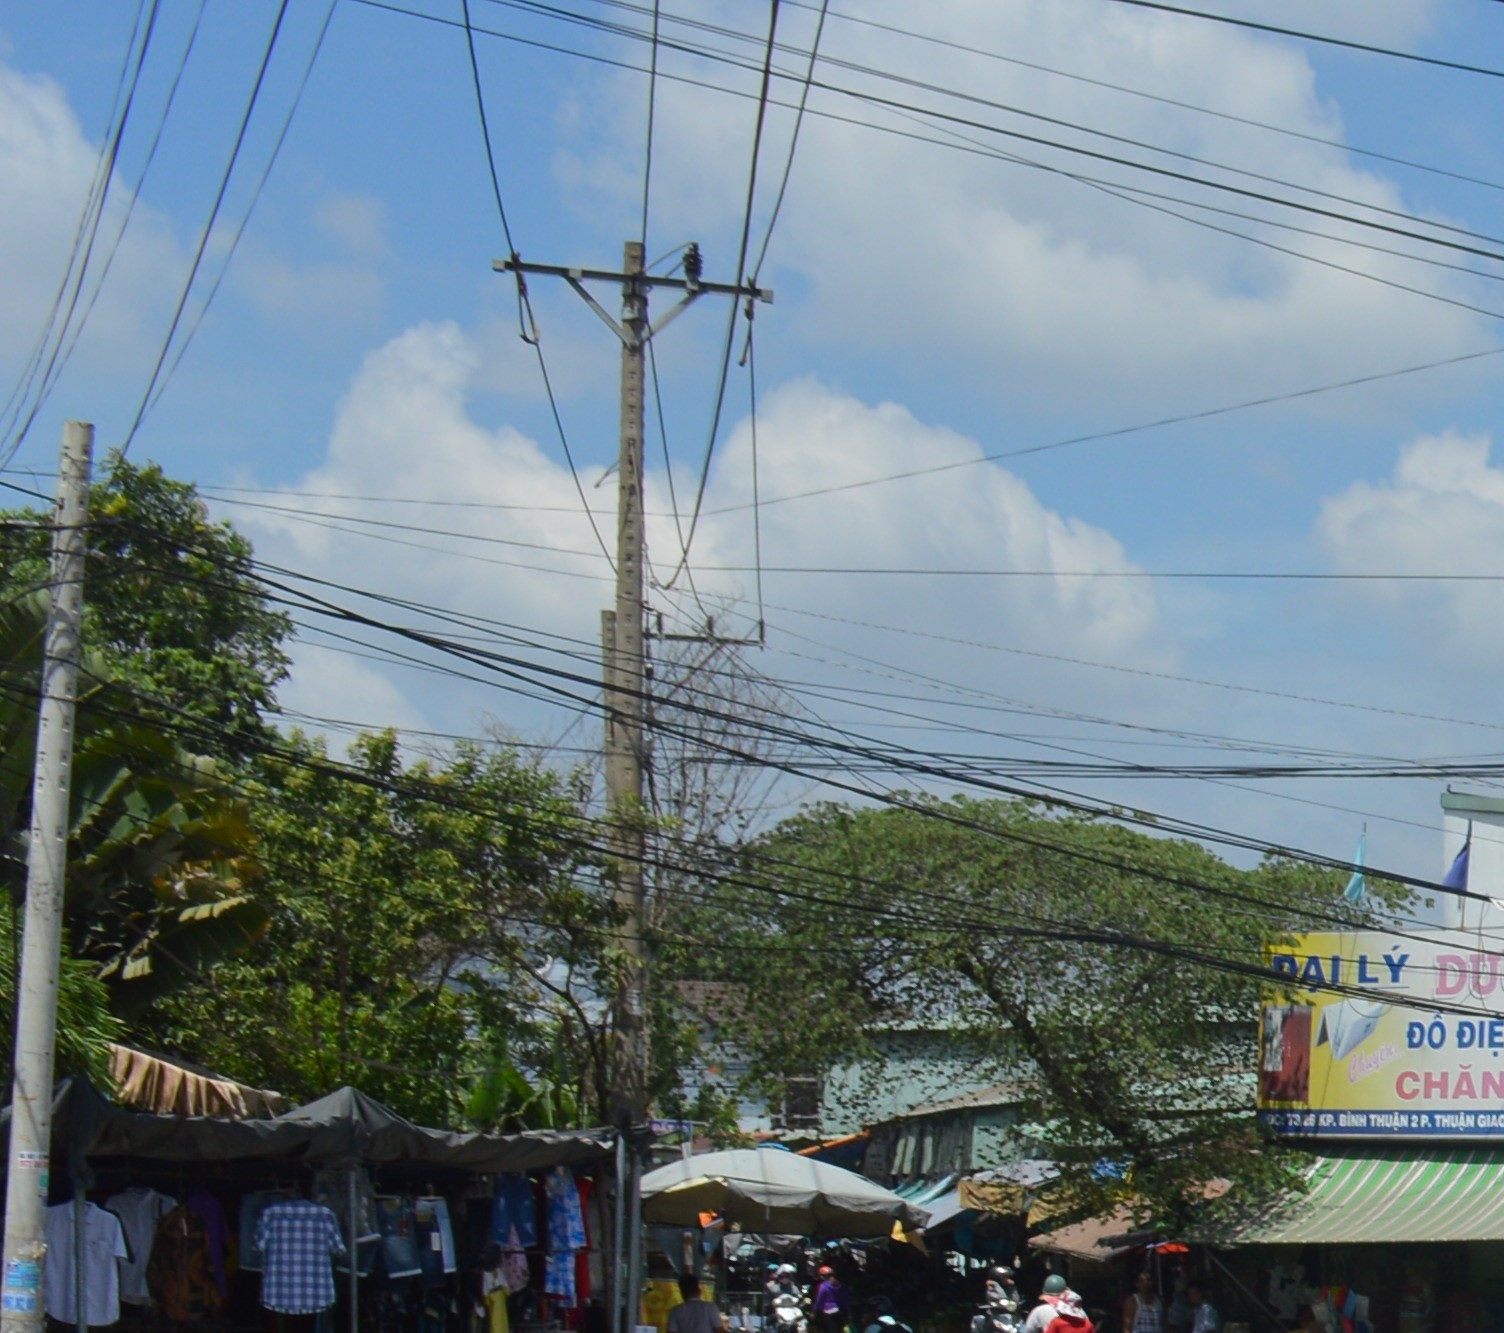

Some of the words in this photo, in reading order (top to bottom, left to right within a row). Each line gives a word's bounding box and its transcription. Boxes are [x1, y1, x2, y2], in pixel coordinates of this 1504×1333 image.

[1358, 945, 1411, 983] LÝ
[1338, 1111, 1368, 1128] BÌNH
[1369, 1111, 1409, 1131] THUẬN
[1410, 1115, 1419, 1128] 2
[1433, 1112, 1475, 1131] THUẬN
